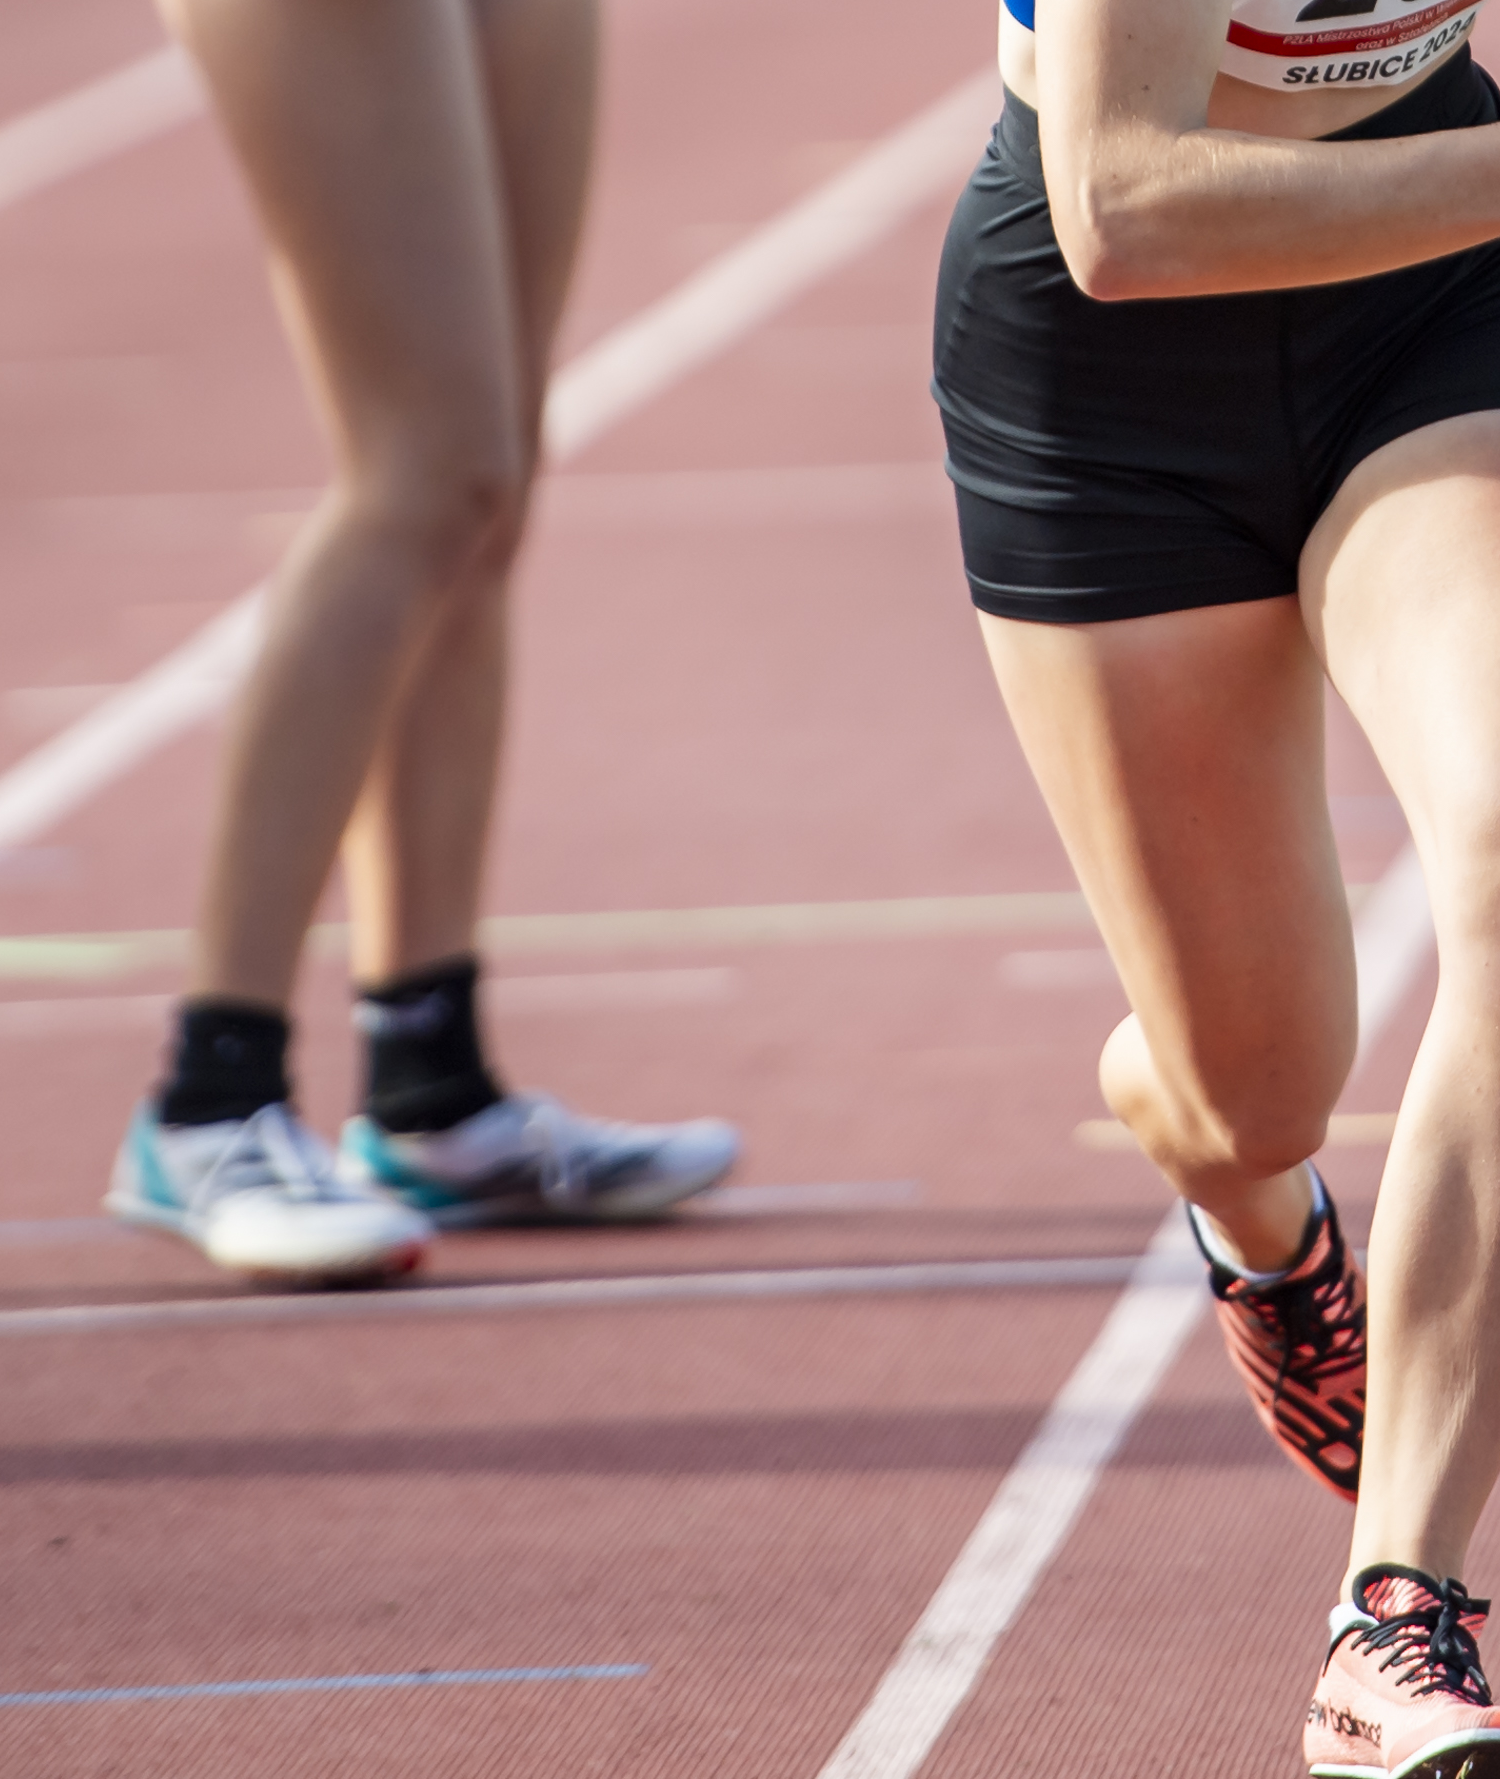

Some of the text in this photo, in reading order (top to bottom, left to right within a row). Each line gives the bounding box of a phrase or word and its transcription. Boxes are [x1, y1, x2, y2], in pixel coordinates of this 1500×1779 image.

[1316, 24, 1390, 43] Mistrzostwa
[1392, 10, 1424, 30] Polski
[1282, 11, 1476, 83] SŁUBICE 2024
[1355, 40, 1383, 51] oraz
[1386, 36, 1396, 46] w
